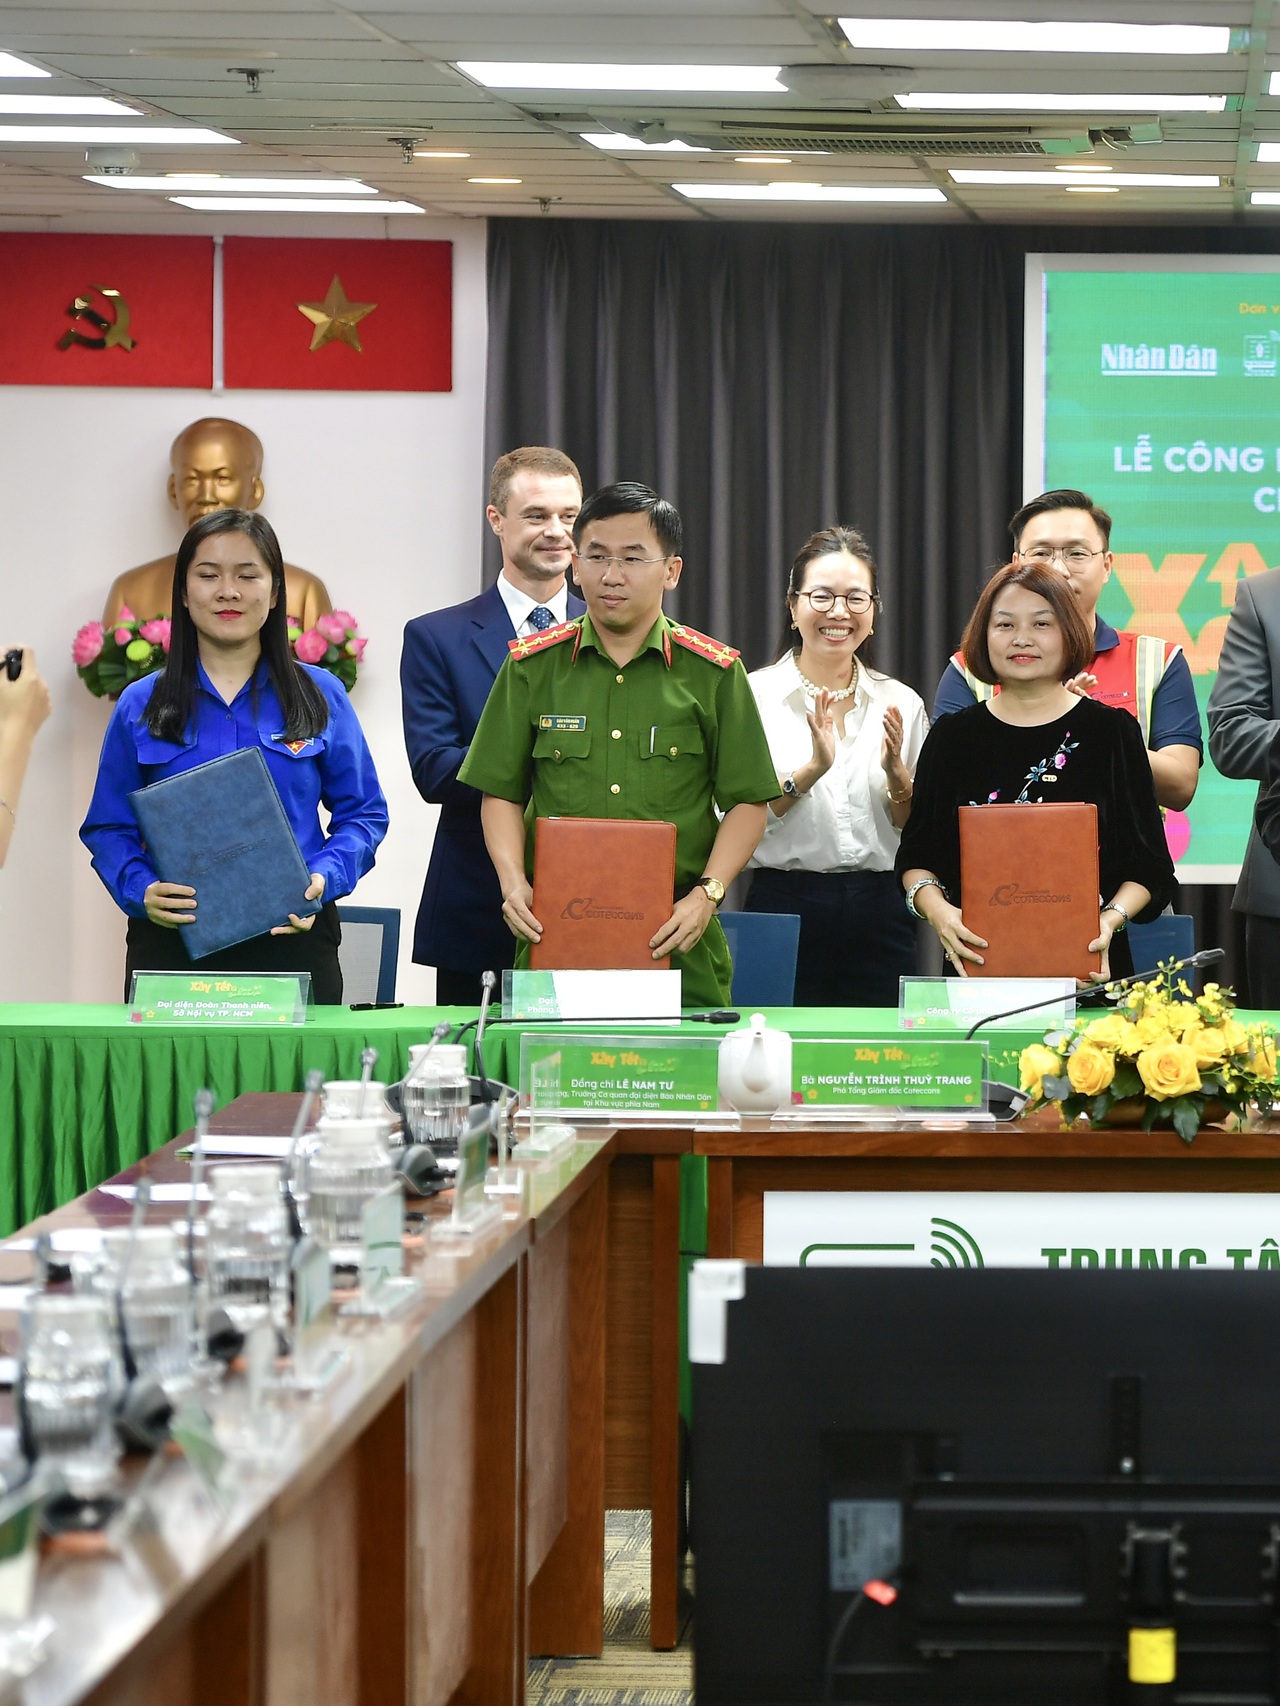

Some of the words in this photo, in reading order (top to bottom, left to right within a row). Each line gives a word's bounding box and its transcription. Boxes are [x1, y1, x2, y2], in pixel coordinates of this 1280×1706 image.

[1101, 343, 1166, 370] Nhân
[1169, 343, 1217, 370] Dân
[1114, 434, 1153, 472] LỄ
[1164, 440, 1264, 473] CÔNG
[190, 981, 211, 993] Xây
[157, 1001, 172, 1009] Đại
[175, 1000, 193, 1010] diện
[196, 1000, 220, 1009] Đoàn
[222, 1001, 249, 1009] Thanh
[591, 1052, 616, 1068] Xây
[620, 1051, 639, 1066] Tết
[855, 1048, 880, 1064] Xây
[883, 1046, 903, 1061] Tết
[571, 1078, 597, 1090] Đồng
[599, 1079, 614, 1089] chí
[616, 1078, 629, 1090] LÊ
[632, 1080, 656, 1090] NAM
[659, 1080, 674, 1090] TƯ
[802, 1074, 815, 1085] Bà
[817, 1072, 862, 1085] NGUYỄN
[865, 1075, 900, 1085] TRÌNH
[936, 1076, 972, 1085] TRANG
[610, 1092, 628, 1100] quan
[629, 1091, 641, 1100] đại
[643, 1091, 659, 1100] diện
[660, 1092, 674, 1100] Báo
[675, 1093, 695, 1101] Nhân
[697, 1094, 712, 1102] Dân
[832, 1086, 847, 1094] Phó
[848, 1086, 867, 1095] Tổng
[868, 1086, 887, 1094] Giám
[889, 1086, 902, 1094] đốc
[583, 1099, 593, 1108] tại
[594, 1100, 610, 1108] Khu
[625, 1100, 641, 1108] phía
